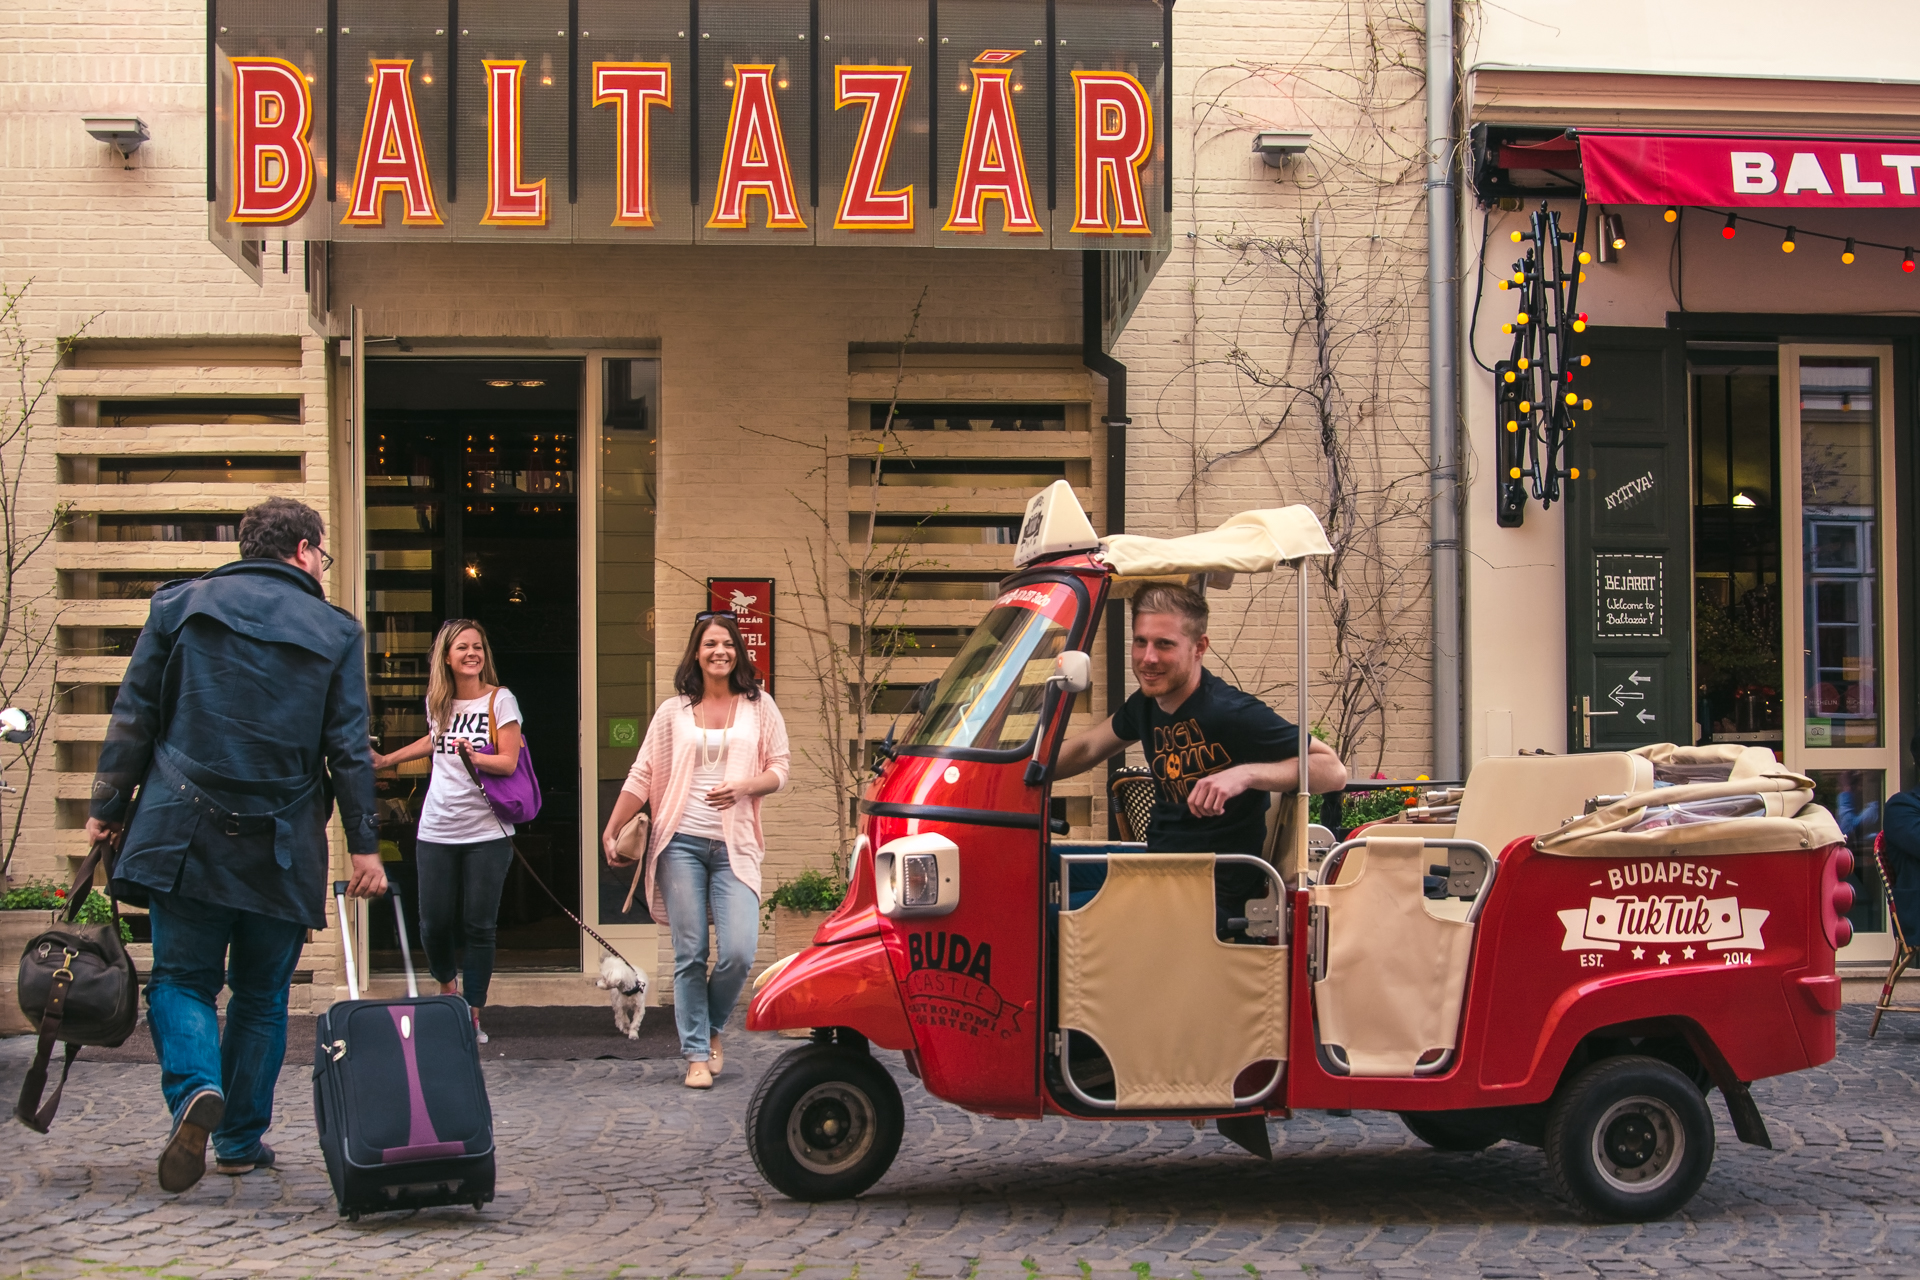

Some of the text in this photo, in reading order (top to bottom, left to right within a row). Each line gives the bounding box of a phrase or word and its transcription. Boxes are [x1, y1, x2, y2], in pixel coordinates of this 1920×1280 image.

[227, 50, 1154, 235] BALTAZÁR
[1730, 151, 1920, 195] BALT
[1604, 471, 1654, 510] NYITVA!
[1604, 569, 1656, 591] BEJÁRAT
[1606, 597, 1656, 610] Welcome to
[445, 713, 490, 734] IKE
[1608, 861, 1722, 890] BUDAPEST
[908, 931, 991, 986] BUDA
[1580, 954, 1604, 968] EST.
[1723, 952, 1752, 966] 2014
[913, 972, 987, 1003] CASTLE
